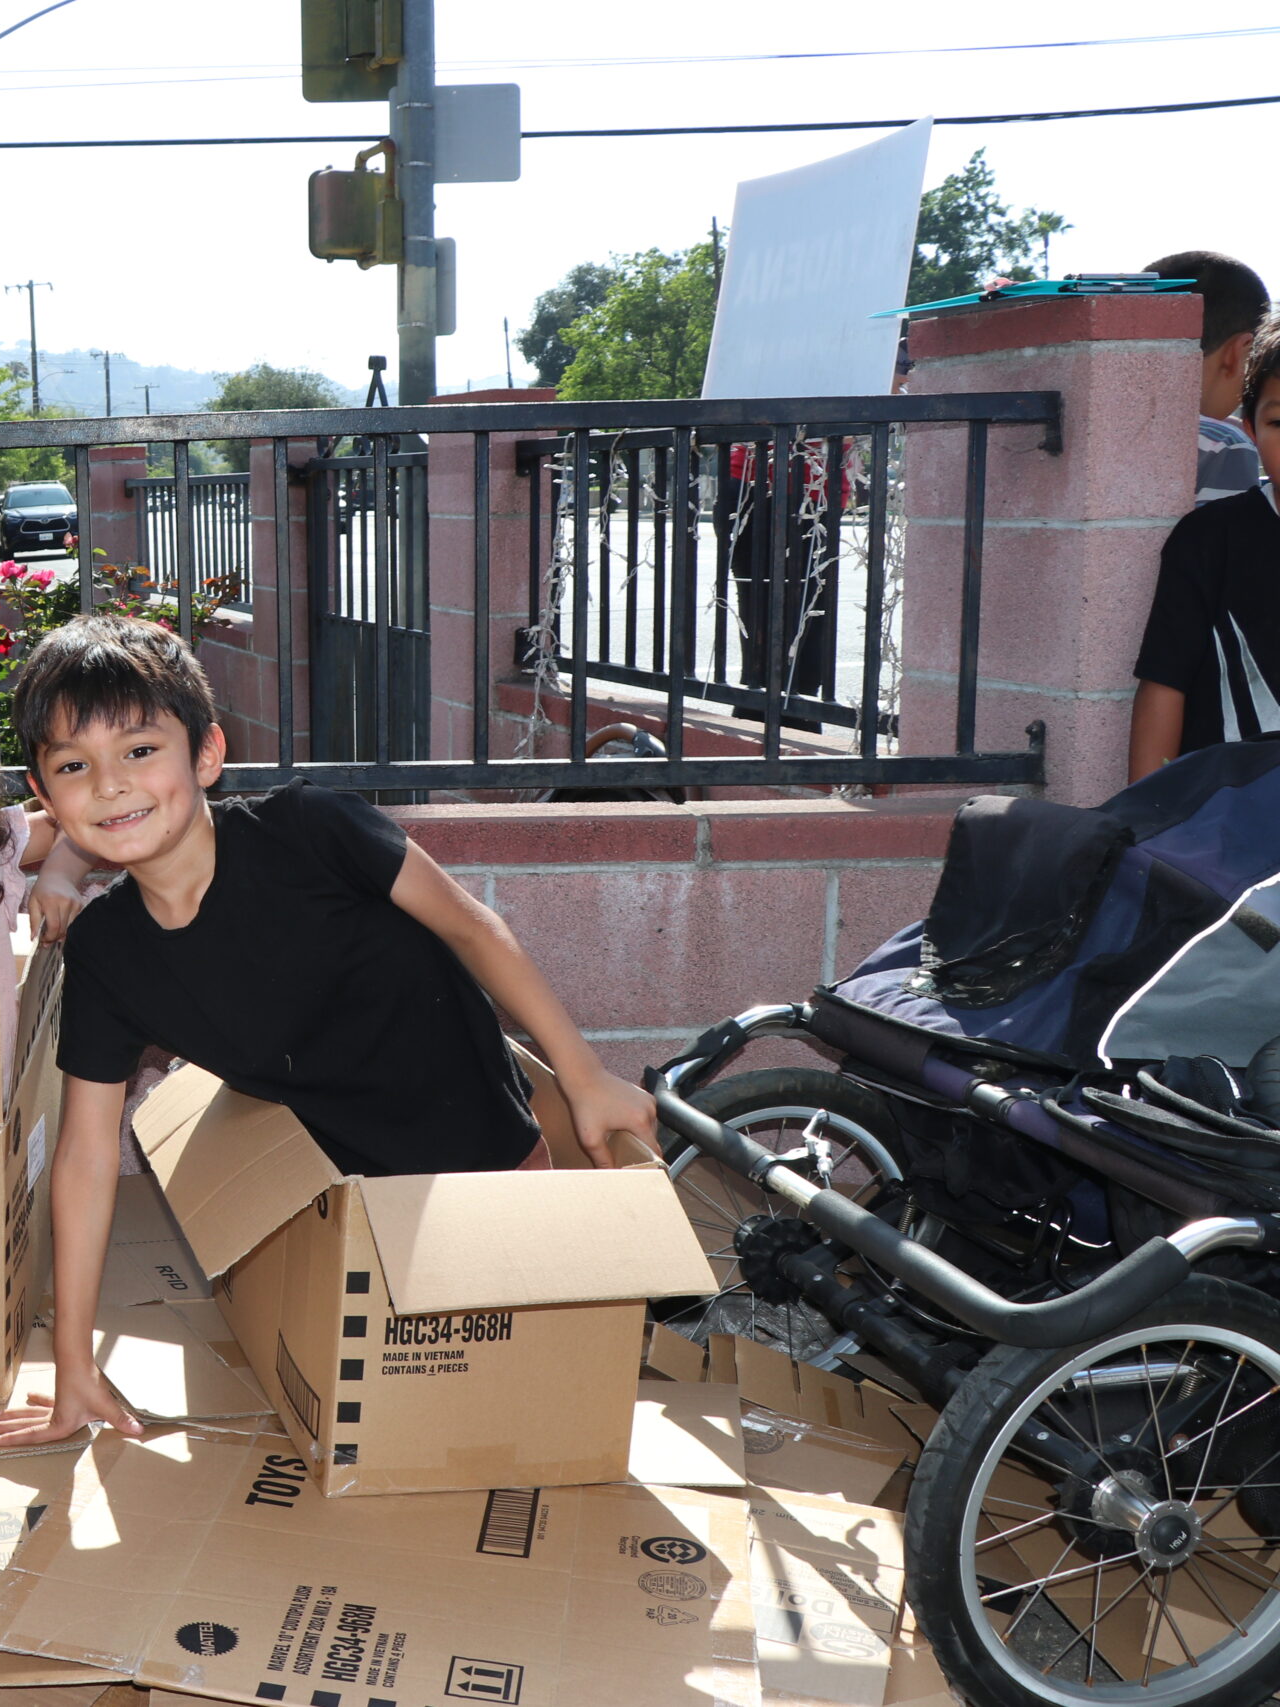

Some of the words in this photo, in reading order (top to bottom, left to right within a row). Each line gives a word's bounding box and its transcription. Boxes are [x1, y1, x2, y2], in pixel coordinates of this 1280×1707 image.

[155, 1265, 189, 1291] RFID
[384, 1312, 513, 1345] HGC34-968H
[383, 1352, 409, 1362] MADE
[412, 1352, 421, 1361] IN
[424, 1350, 464, 1360] VIETNAM
[382, 1365, 426, 1375] CONTAINS
[427, 1365, 436, 1376] 4
[438, 1363, 469, 1373] PIECES
[245, 1455, 308, 1508] TOYS
[1169, 1531, 1187, 1550] PUSH
[292, 1585, 312, 1603] PLUSH
[320, 1586, 338, 1596] 19A
[751, 1585, 834, 1617] Dolls
[282, 1604, 304, 1630] CUUTOPIA
[312, 1606, 330, 1616] MIX
[645, 1607, 656, 1620] PAP
[308, 1619, 325, 1631] 2024
[199, 1622, 215, 1654] MATTEL
[278, 1631, 294, 1642] 10"
[321, 1603, 376, 1682] HGC34-968H
[392, 1632, 407, 1651] PIECES
[267, 1644, 291, 1671] MARVEL
[292, 1631, 320, 1675] ASSORTMENT
[365, 1667, 380, 1686] MADE
[373, 1633, 389, 1658] VIETNAM
[392, 1650, 404, 1659] 4
[383, 1658, 399, 1688] CONTAINS
